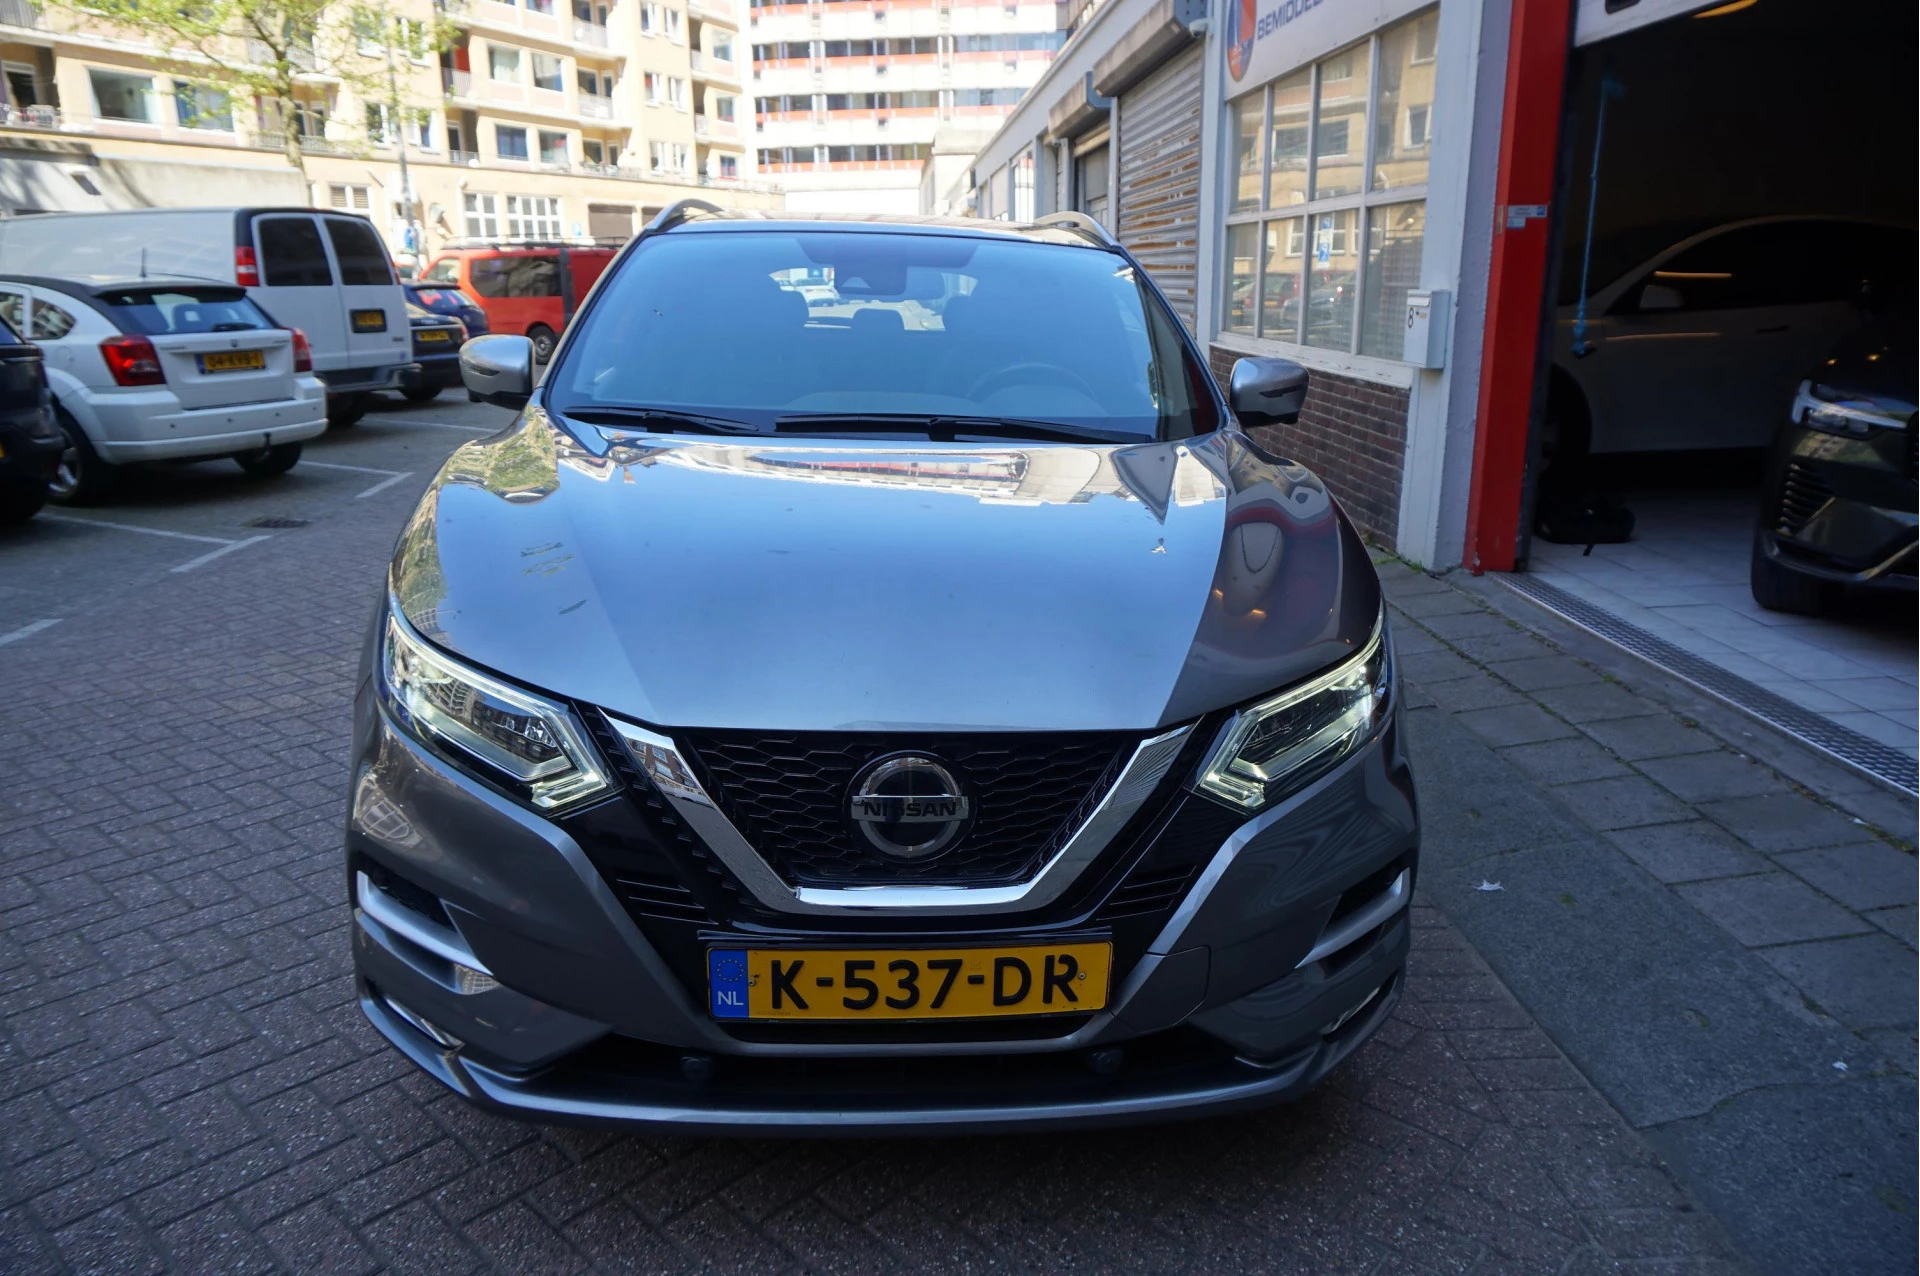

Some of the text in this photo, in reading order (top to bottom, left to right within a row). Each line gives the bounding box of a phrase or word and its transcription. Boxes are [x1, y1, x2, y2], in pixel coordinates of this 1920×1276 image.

[1257, 0, 1323, 40] BEMIDDE
[1407, 306, 1414, 328] 8
[717, 990, 744, 1006] NL
[771, 954, 1079, 1011] K-537-DR
